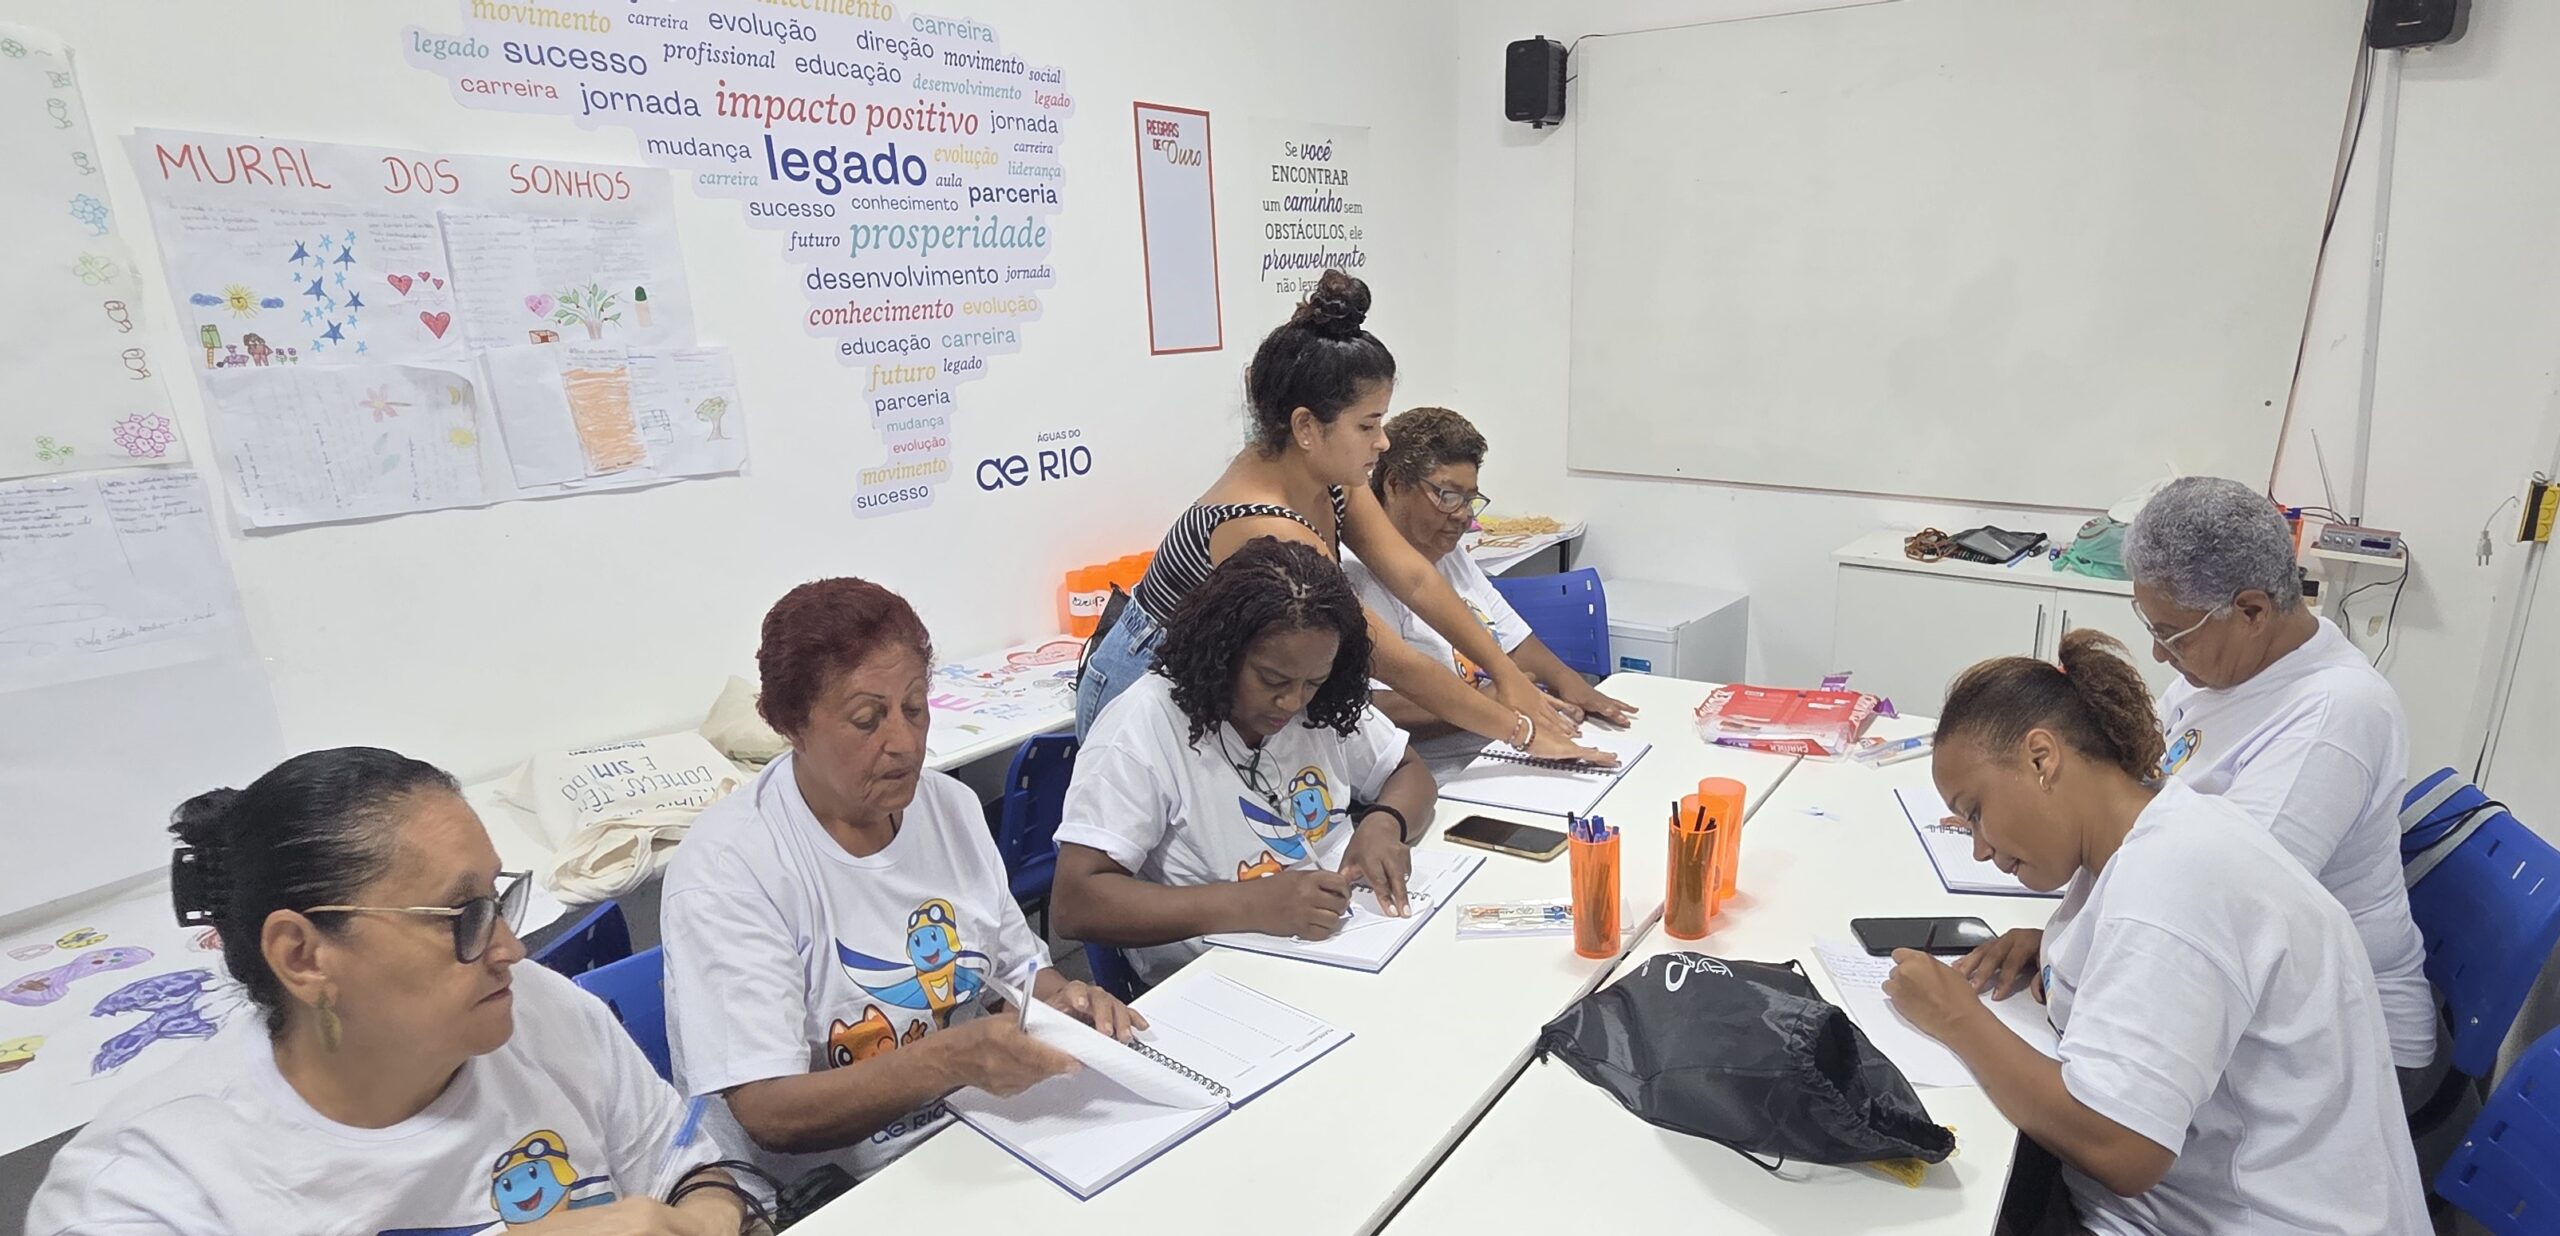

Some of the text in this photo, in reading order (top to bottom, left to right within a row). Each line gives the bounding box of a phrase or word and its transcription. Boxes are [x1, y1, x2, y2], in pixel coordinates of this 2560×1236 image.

[472, 0, 612, 34] movimento
[627, 12, 689, 31] carreira
[708, 12, 817, 45] evolução
[912, 14, 994, 43] carreira
[412, 31, 489, 61] legado
[662, 41, 776, 69] profissional
[856, 30, 934, 61] direção
[503, 41, 648, 76] sucesso
[795, 54, 902, 86] educação
[943, 49, 1025, 76] movimento
[460, 77, 559, 100] carreira
[912, 73, 1022, 101] desenvolvimento
[1028, 68, 1061, 85] social
[580, 82, 702, 117] jornada
[716, 79, 979, 136] impacto positivo
[1033, 90, 1071, 110] legado
[989, 108, 1059, 134] jornada
[1146, 119, 1180, 138] REGRAS
[647, 136, 752, 164] mudança
[935, 145, 998, 170] evolução
[1013, 141, 1053, 154] carreira
[1153, 138, 1202, 167] DE Ouro
[1284, 138, 1333, 162] Se você
[155, 143, 631, 201] MURAL DOS SONHOS
[764, 133, 927, 196] legado
[1008, 161, 1061, 180] liderança
[1271, 164, 1349, 186] ENCONTRAR
[699, 171, 759, 187] carreira
[935, 172, 963, 189] aula
[851, 194, 959, 212] conhecimento
[968, 182, 1058, 208] parceria
[1262, 188, 1363, 214] um caminho sem
[749, 200, 836, 218] sucesso
[789, 232, 840, 252] futuro
[849, 215, 1047, 258] prosperidade
[1265, 218, 1363, 242] OBSTÁCULOS, ele
[1003, 264, 1051, 283] jornada
[1261, 244, 1367, 283] provavelmente
[806, 265, 999, 290] desenvolvimento
[1276, 277, 1297, 294] não
[809, 298, 954, 326] conhecimento
[962, 295, 1038, 316] evolução
[841, 333, 931, 357] educação
[941, 327, 1016, 349] carreira
[943, 355, 983, 375] legado
[868, 363, 937, 393] futuro
[874, 387, 951, 417] parceria
[886, 414, 945, 433] mudança
[1037, 428, 1081, 443] ÁGUAS DO
[892, 435, 946, 454] evolução
[862, 456, 947, 487] movimento
[1039, 445, 1093, 482] RIO
[856, 484, 930, 509] sucesso
[913, 1102, 947, 1130] RIO
